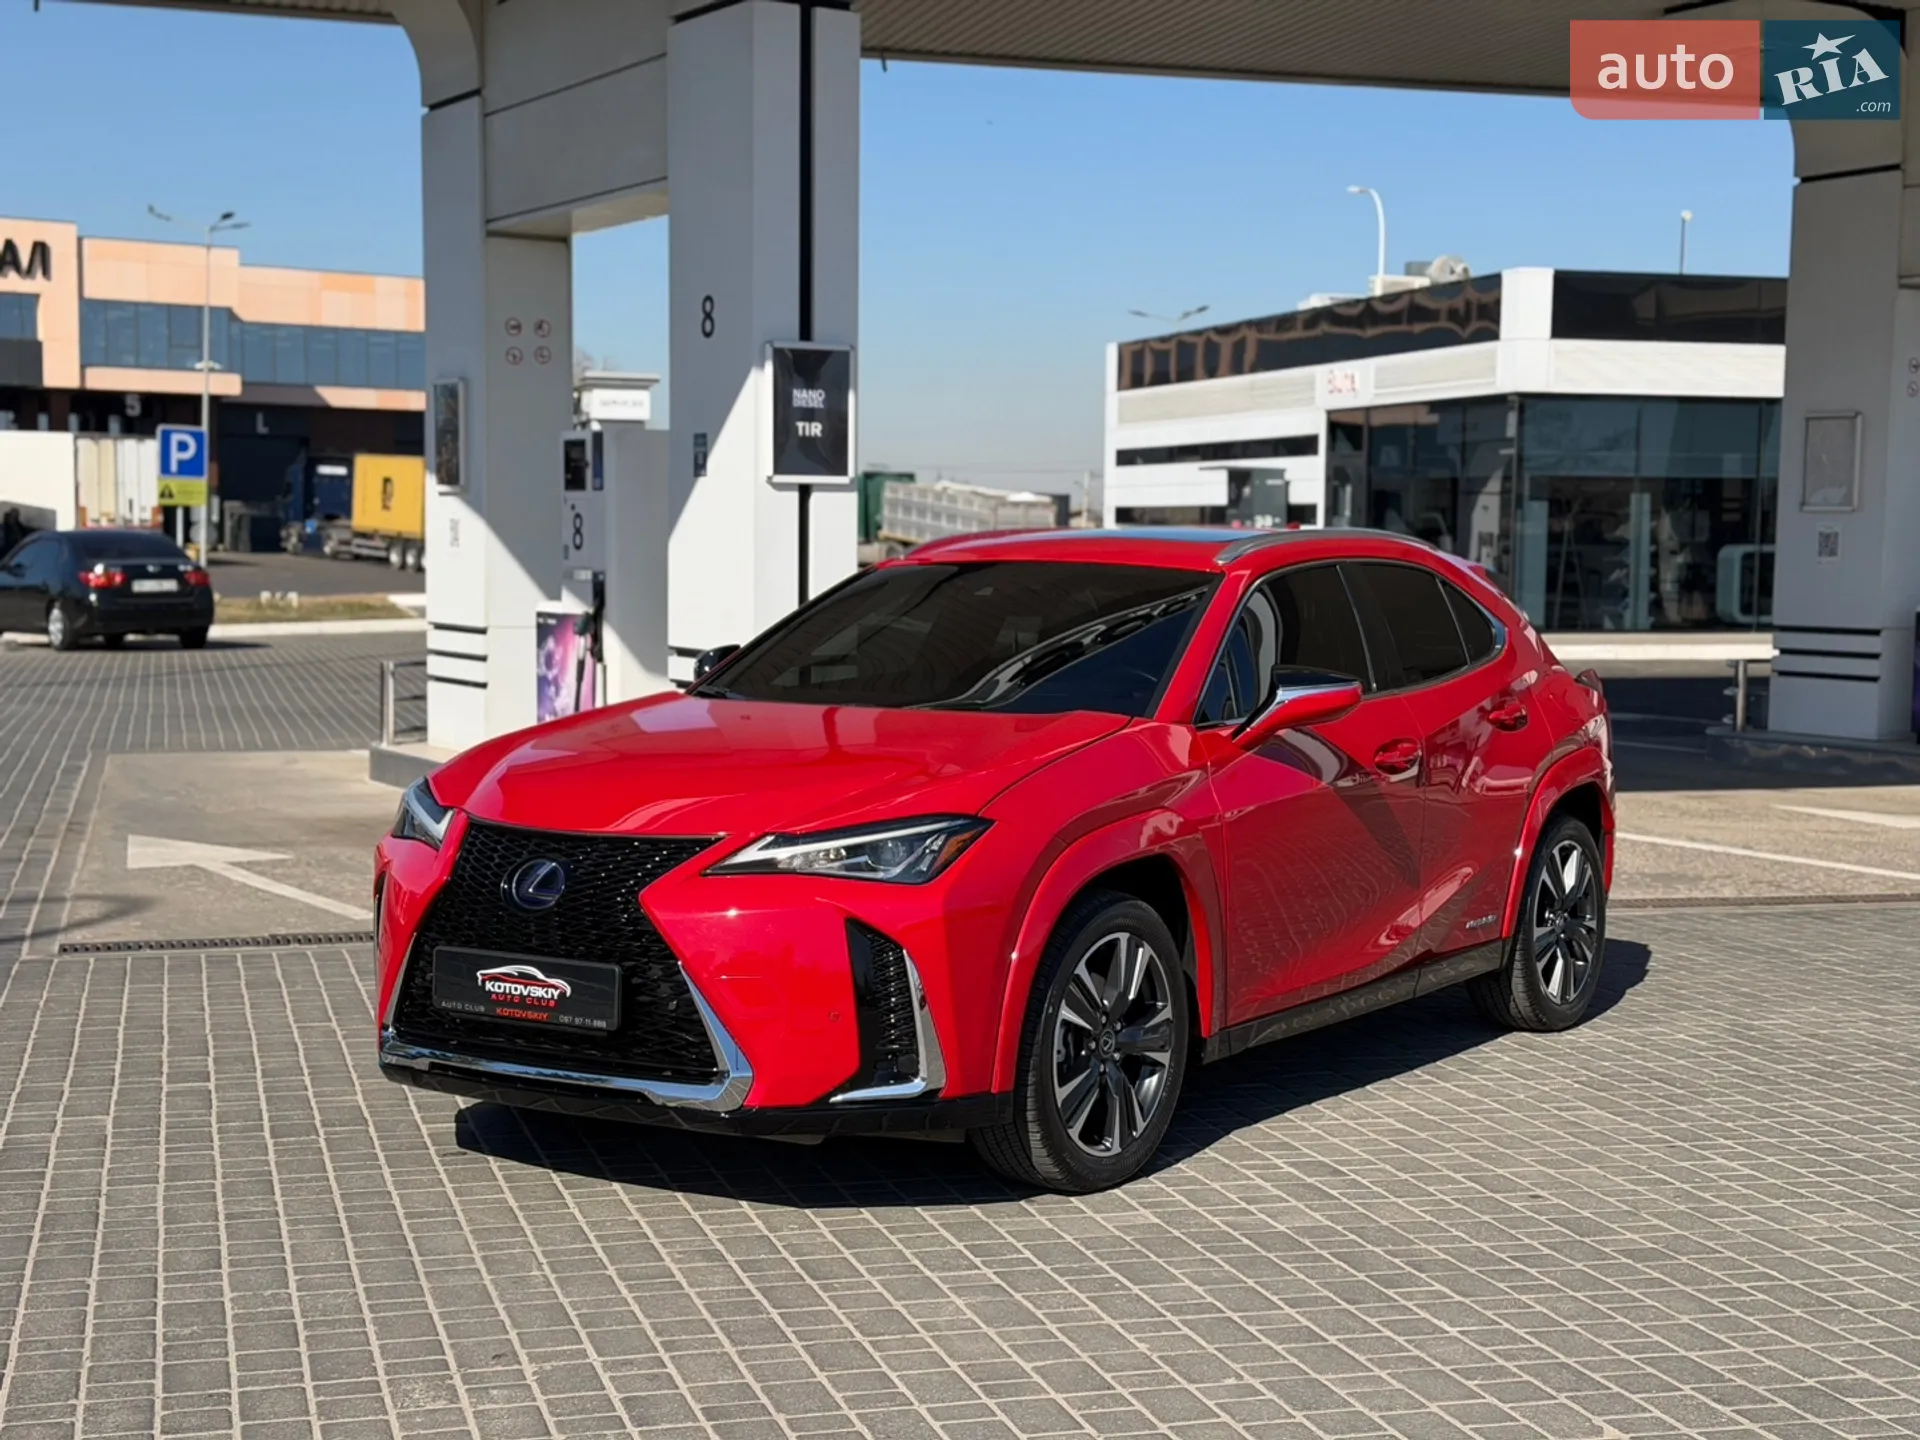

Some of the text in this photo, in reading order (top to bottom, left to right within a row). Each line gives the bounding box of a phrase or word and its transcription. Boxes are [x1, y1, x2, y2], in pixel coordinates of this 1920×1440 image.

[701, 294, 715, 339] 8
[792, 388, 826, 400] NANO
[792, 399, 825, 409] DIESEL
[795, 421, 823, 438] TIR
[169, 432, 198, 474] P
[572, 512, 584, 551] 8
[485, 980, 561, 1000] KOTOVSKIY
[441, 1001, 486, 1012] AUTO CLUB
[490, 993, 556, 1007] AUTO CLUB
[496, 1008, 549, 1021] KOTOVSKIY
